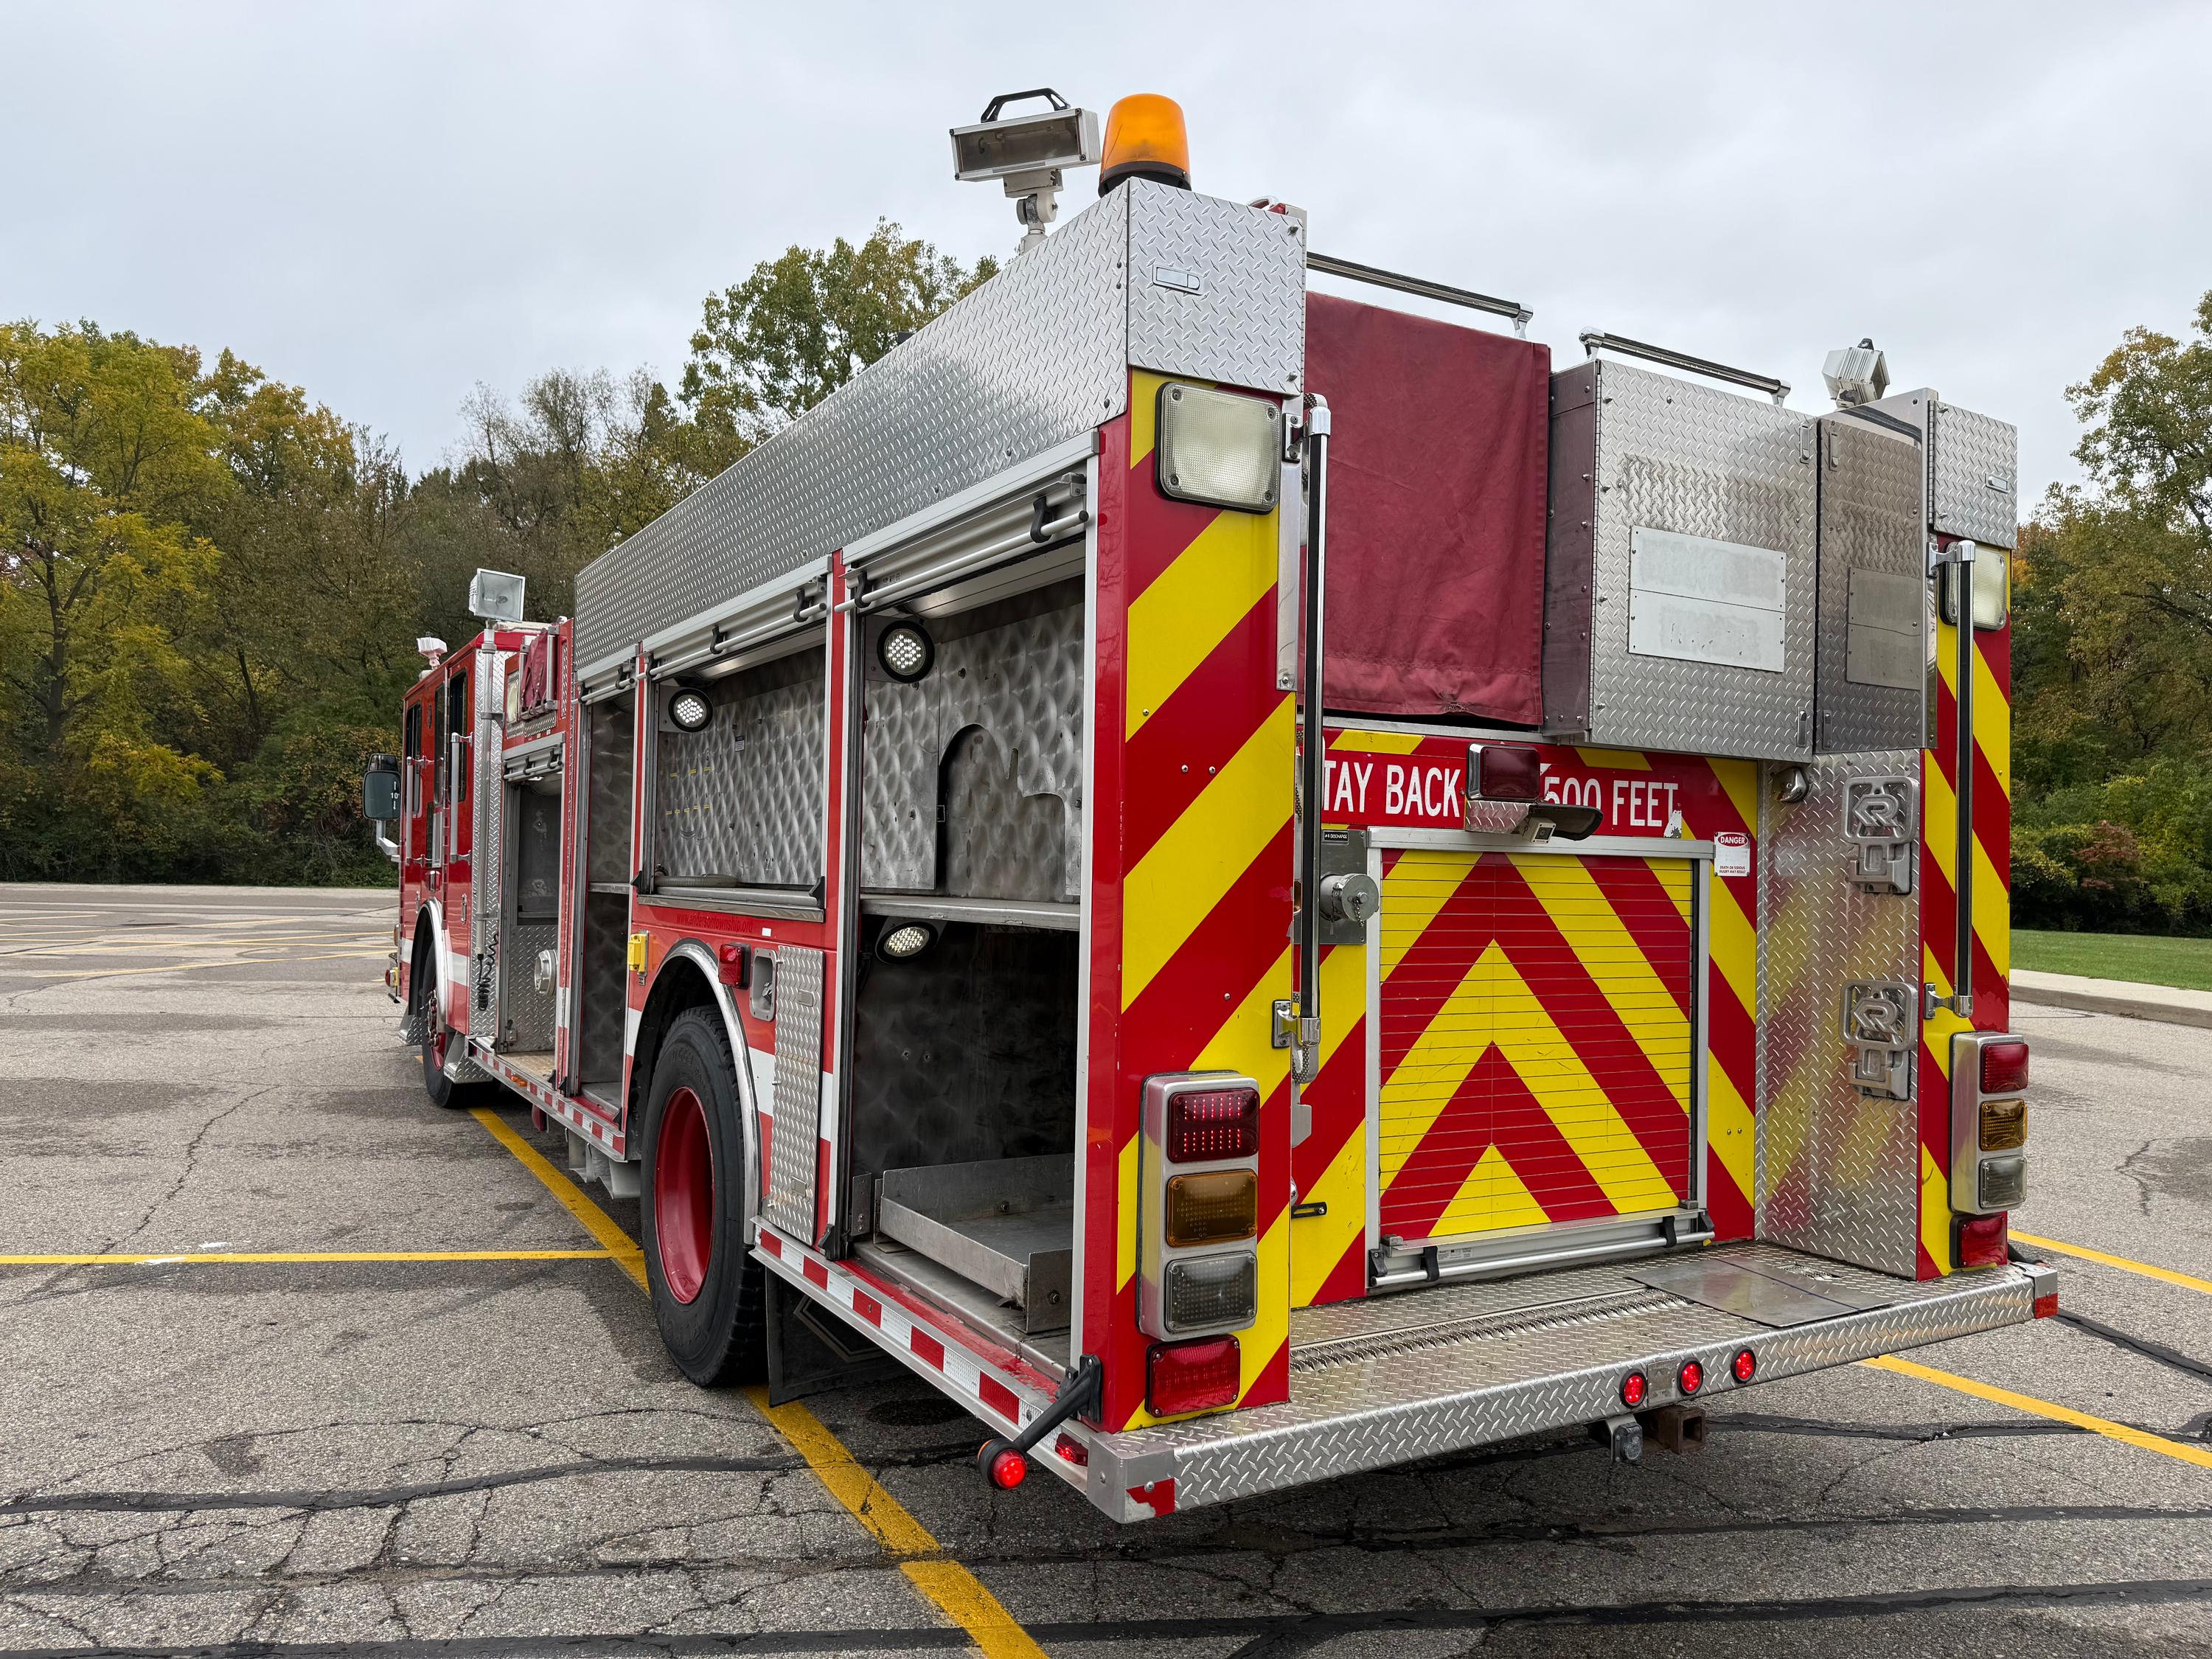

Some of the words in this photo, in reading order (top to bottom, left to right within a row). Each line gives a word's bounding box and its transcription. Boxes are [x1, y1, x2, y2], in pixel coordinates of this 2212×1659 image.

[1324, 760, 1374, 813] TAY
[1385, 765, 1461, 817] BACK
[1613, 780, 1678, 827] FEET
[1720, 836, 1745, 844] DANGER
